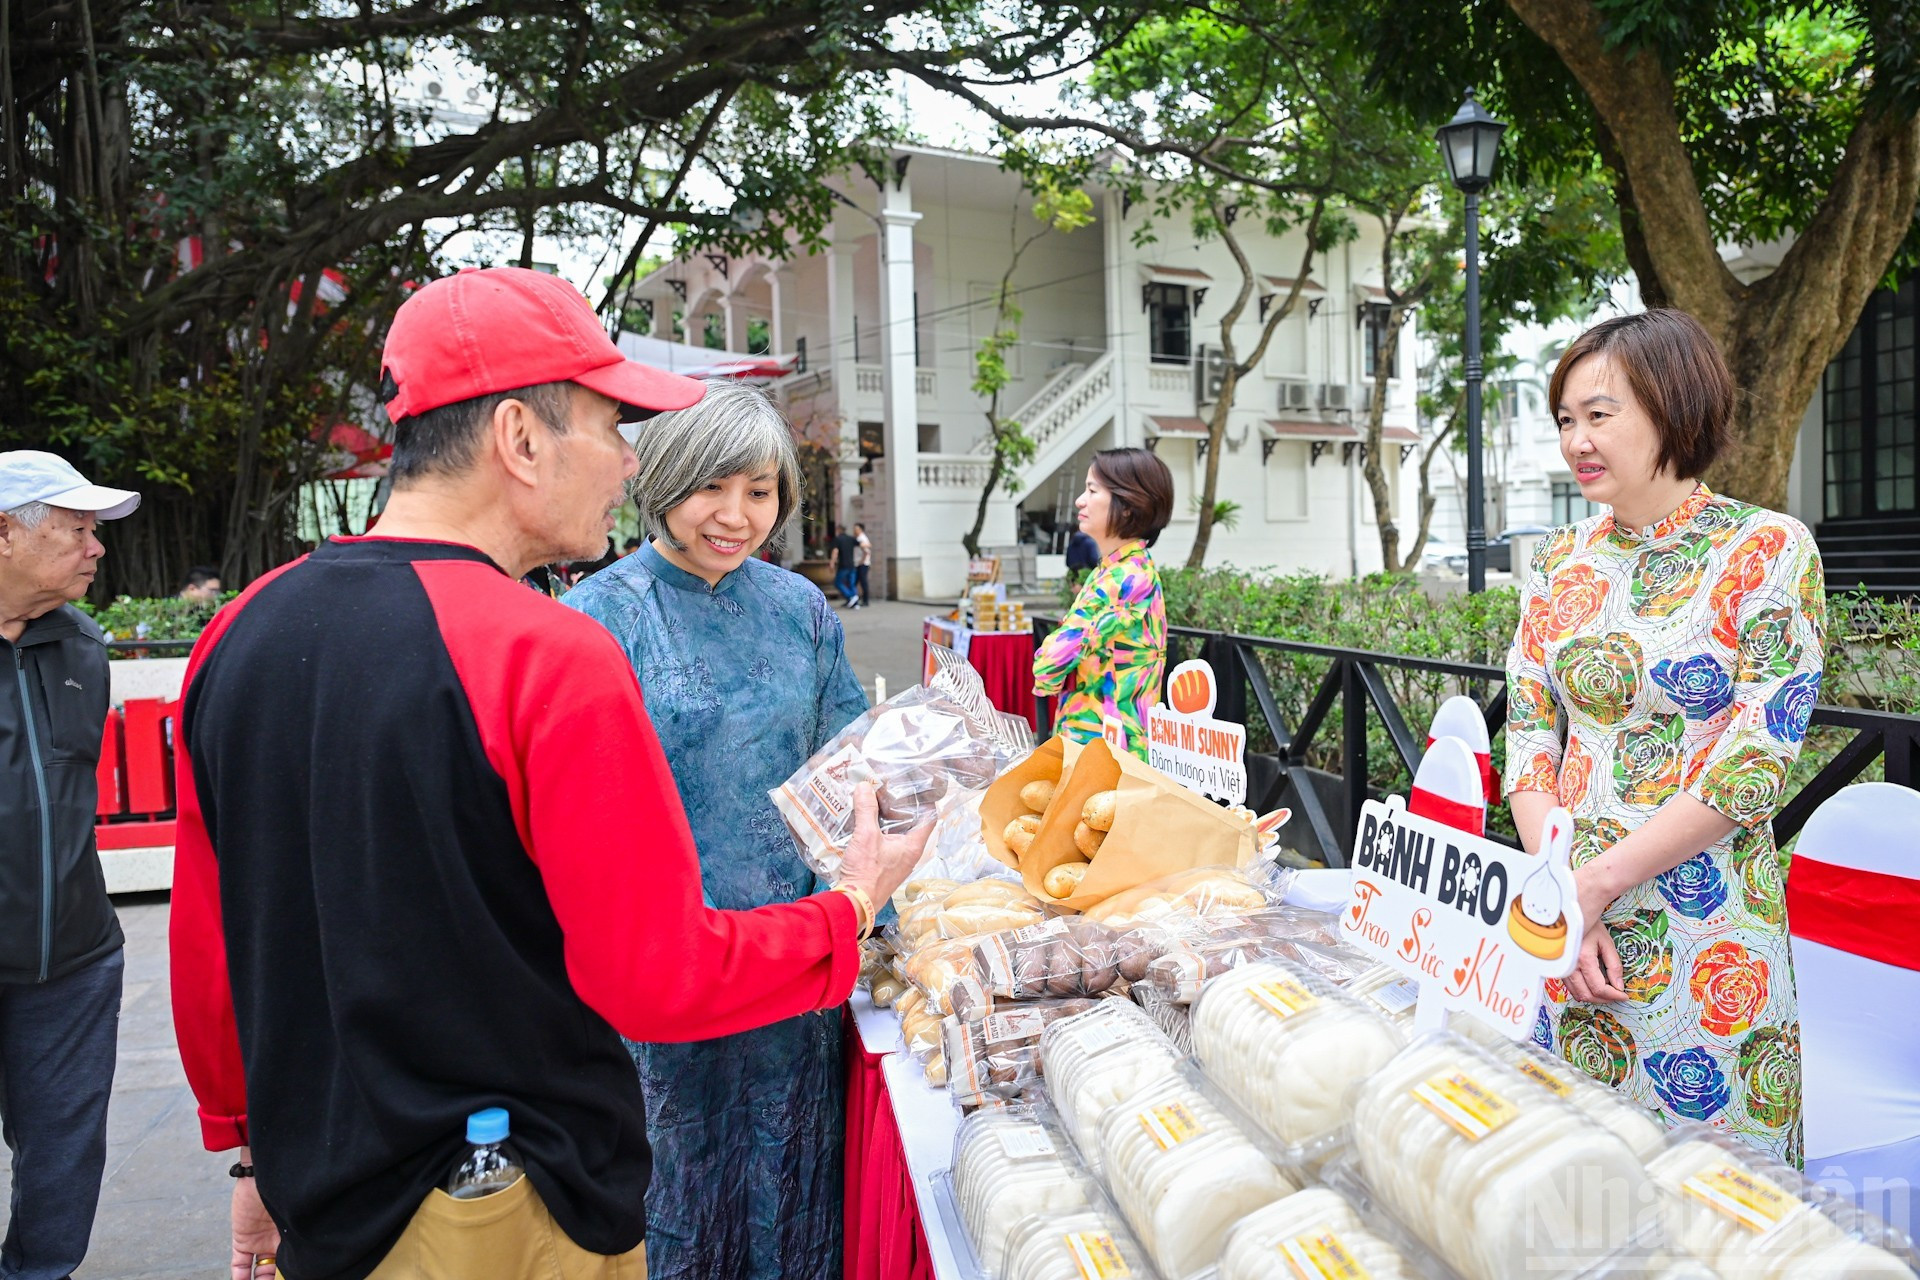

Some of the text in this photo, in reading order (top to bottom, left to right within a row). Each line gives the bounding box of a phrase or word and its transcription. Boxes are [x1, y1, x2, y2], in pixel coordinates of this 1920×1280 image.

[1150, 713, 1239, 763] BÁNH MÌ SUNNY
[812, 776, 845, 813] FRESH DAILY
[1208, 766, 1217, 792] vị
[1219, 767, 1241, 798] Việt
[1358, 809, 1508, 926] BÁNH BAO
[1345, 880, 1390, 948] Trao
[1397, 907, 1445, 979] Sức
[1445, 937, 1528, 1024] Khoẻ
